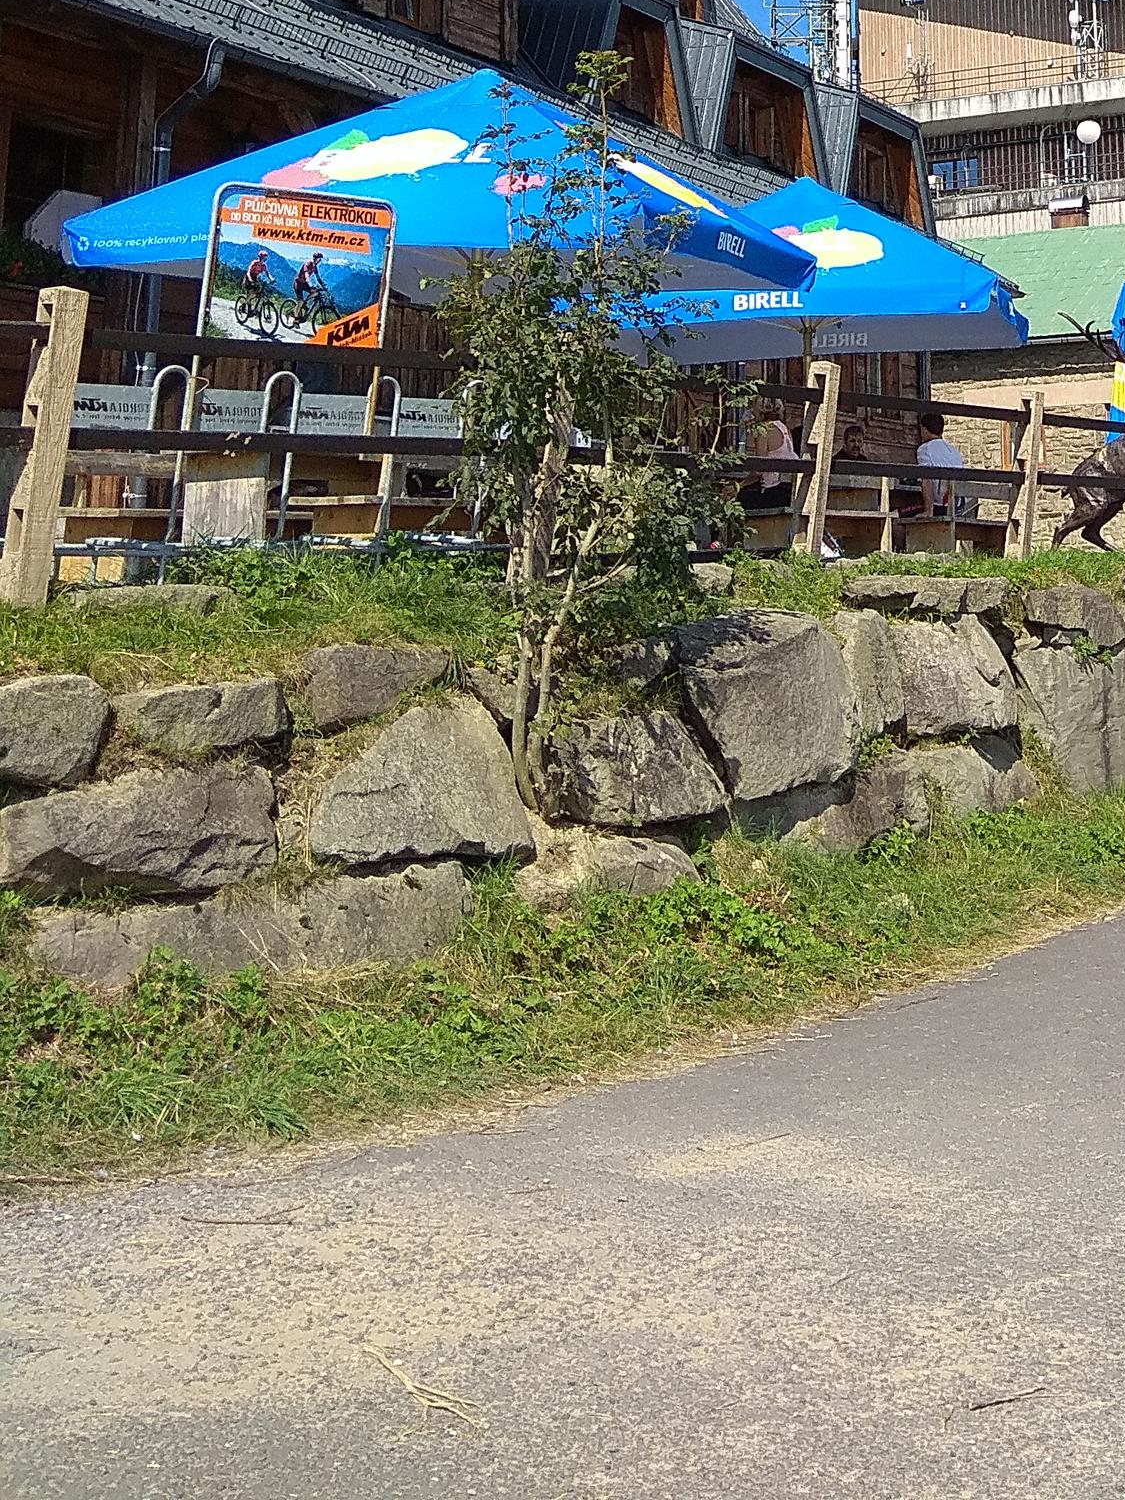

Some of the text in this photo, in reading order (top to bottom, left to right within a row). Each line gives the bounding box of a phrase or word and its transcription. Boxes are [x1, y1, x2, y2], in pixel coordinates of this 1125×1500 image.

[242, 212, 260, 223] 600
[273, 217, 284, 225] NA
[301, 203, 379, 225] ELEKTROKOL
[93, 238, 122, 248] 100%
[257, 226, 366, 246] www.ktm-fm.cz
[717, 231, 746, 258] BIRELL
[733, 291, 804, 311] BIRELL
[327, 315, 370, 346] KTM
